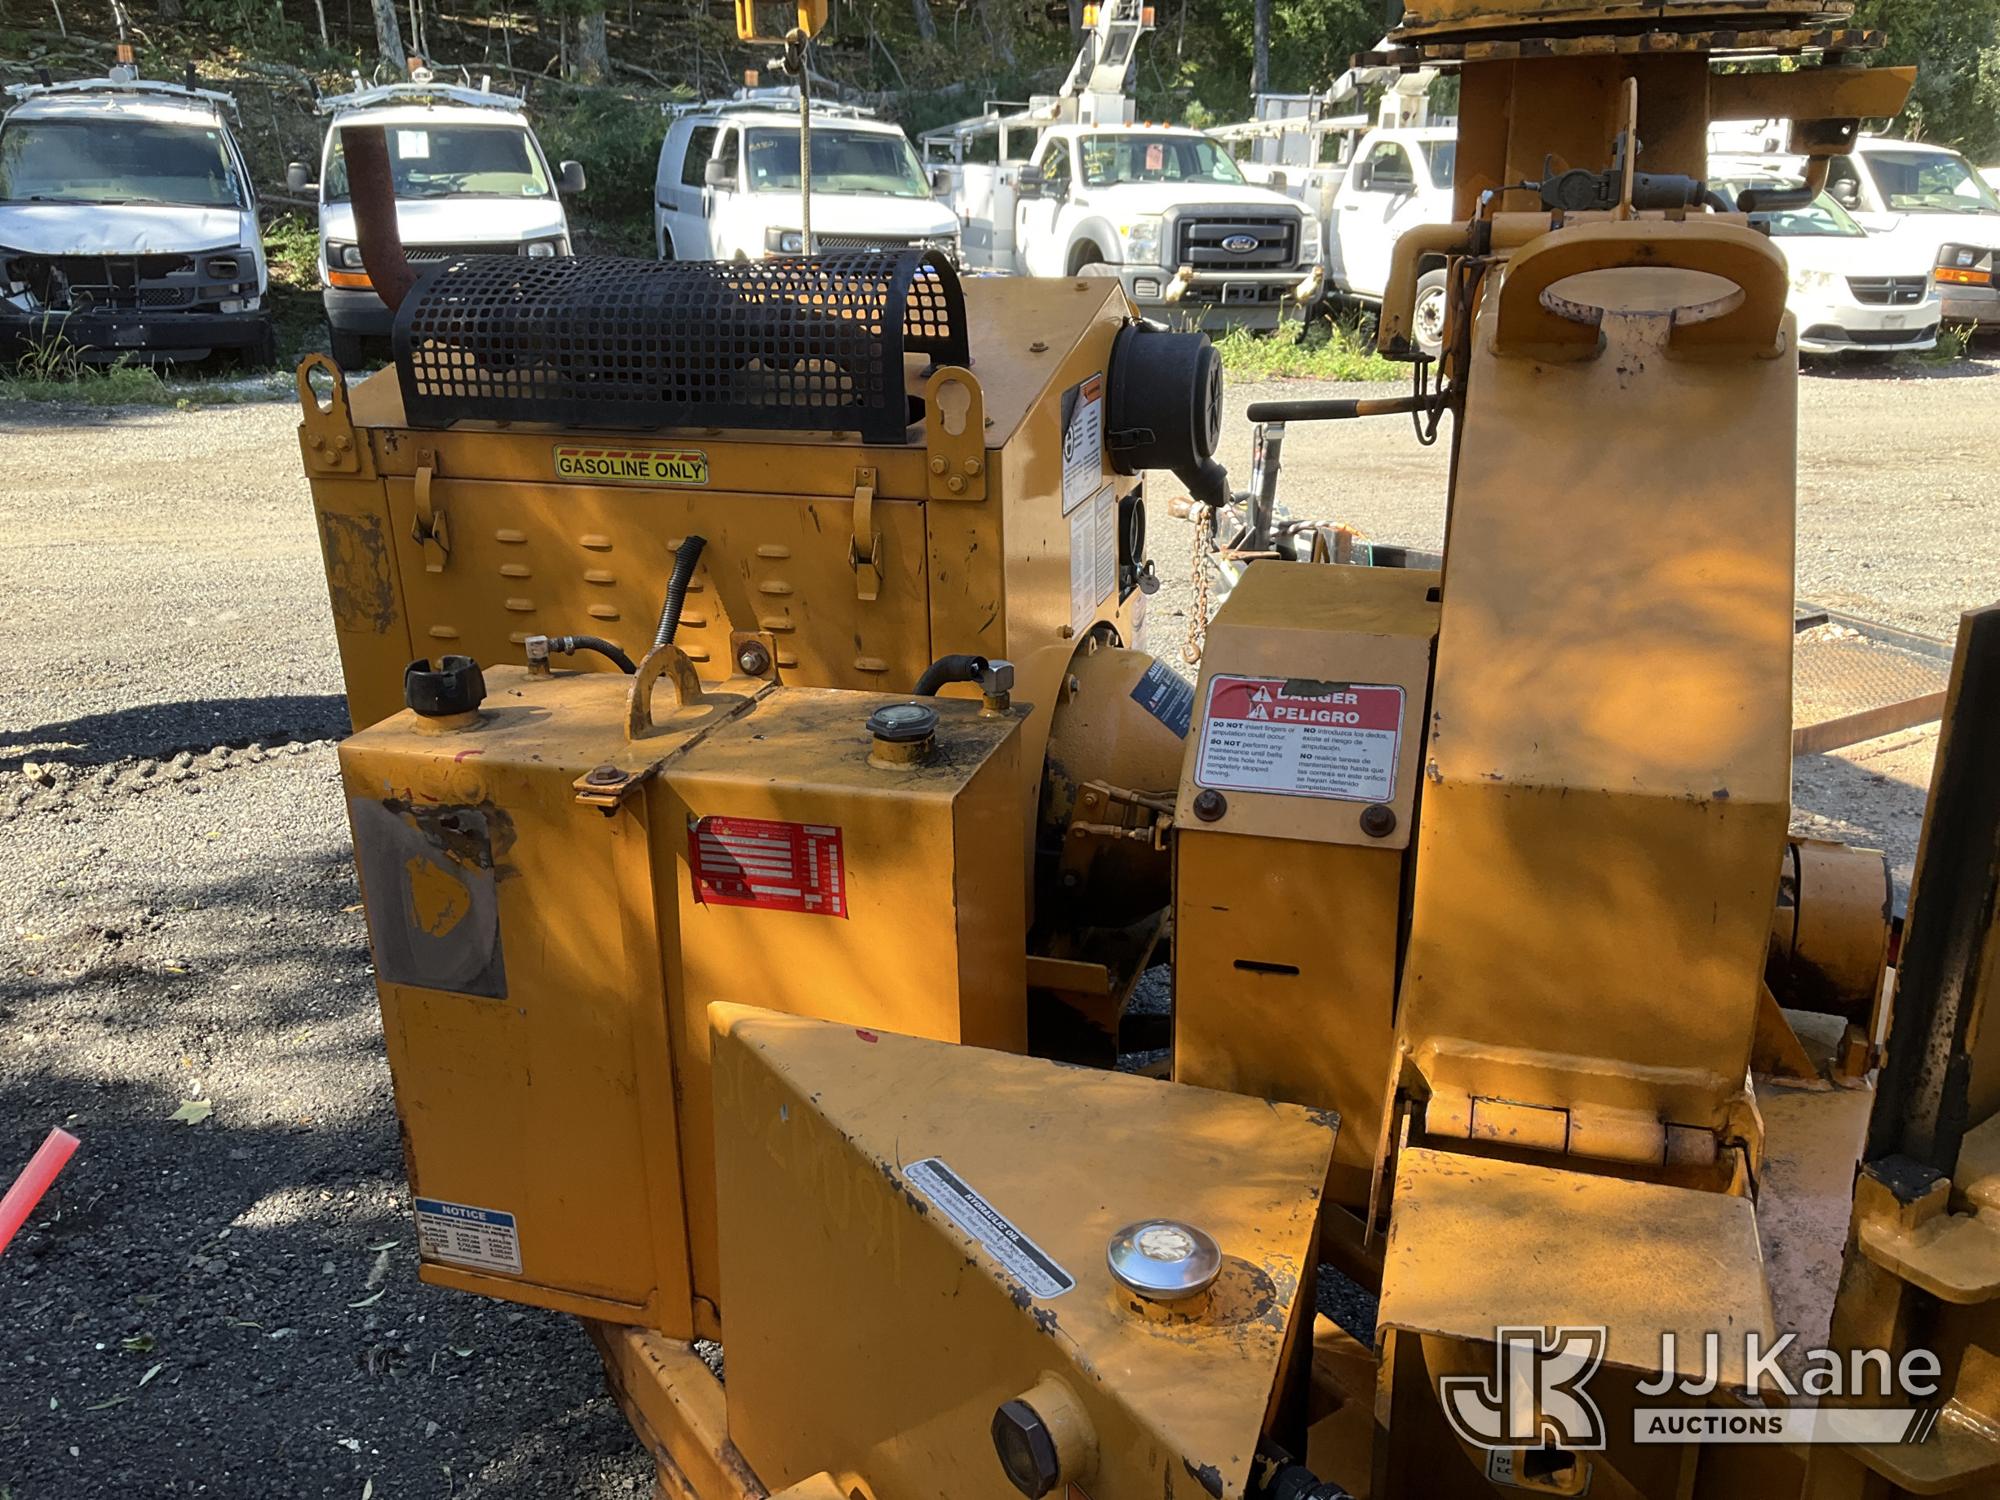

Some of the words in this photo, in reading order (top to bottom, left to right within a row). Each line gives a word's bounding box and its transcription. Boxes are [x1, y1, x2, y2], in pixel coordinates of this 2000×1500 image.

[559, 458, 650, 476] GASOLINE
[655, 462, 702, 478] ONLY
[1273, 706, 1360, 724] PELIGRO
[1212, 729, 1246, 737] amputation
[1265, 725, 1286, 733] fingers
[1209, 747, 1249, 755] maintenance
[1207, 762, 1241, 771] completely
[1299, 762, 1348, 770] mantenimiento
[1330, 779, 1359, 787] detenido
[442, 1205, 487, 1221] NOTICE
[964, 1193, 1007, 1230] HYDRAULIC
[1005, 1229, 1020, 1242] OIL
